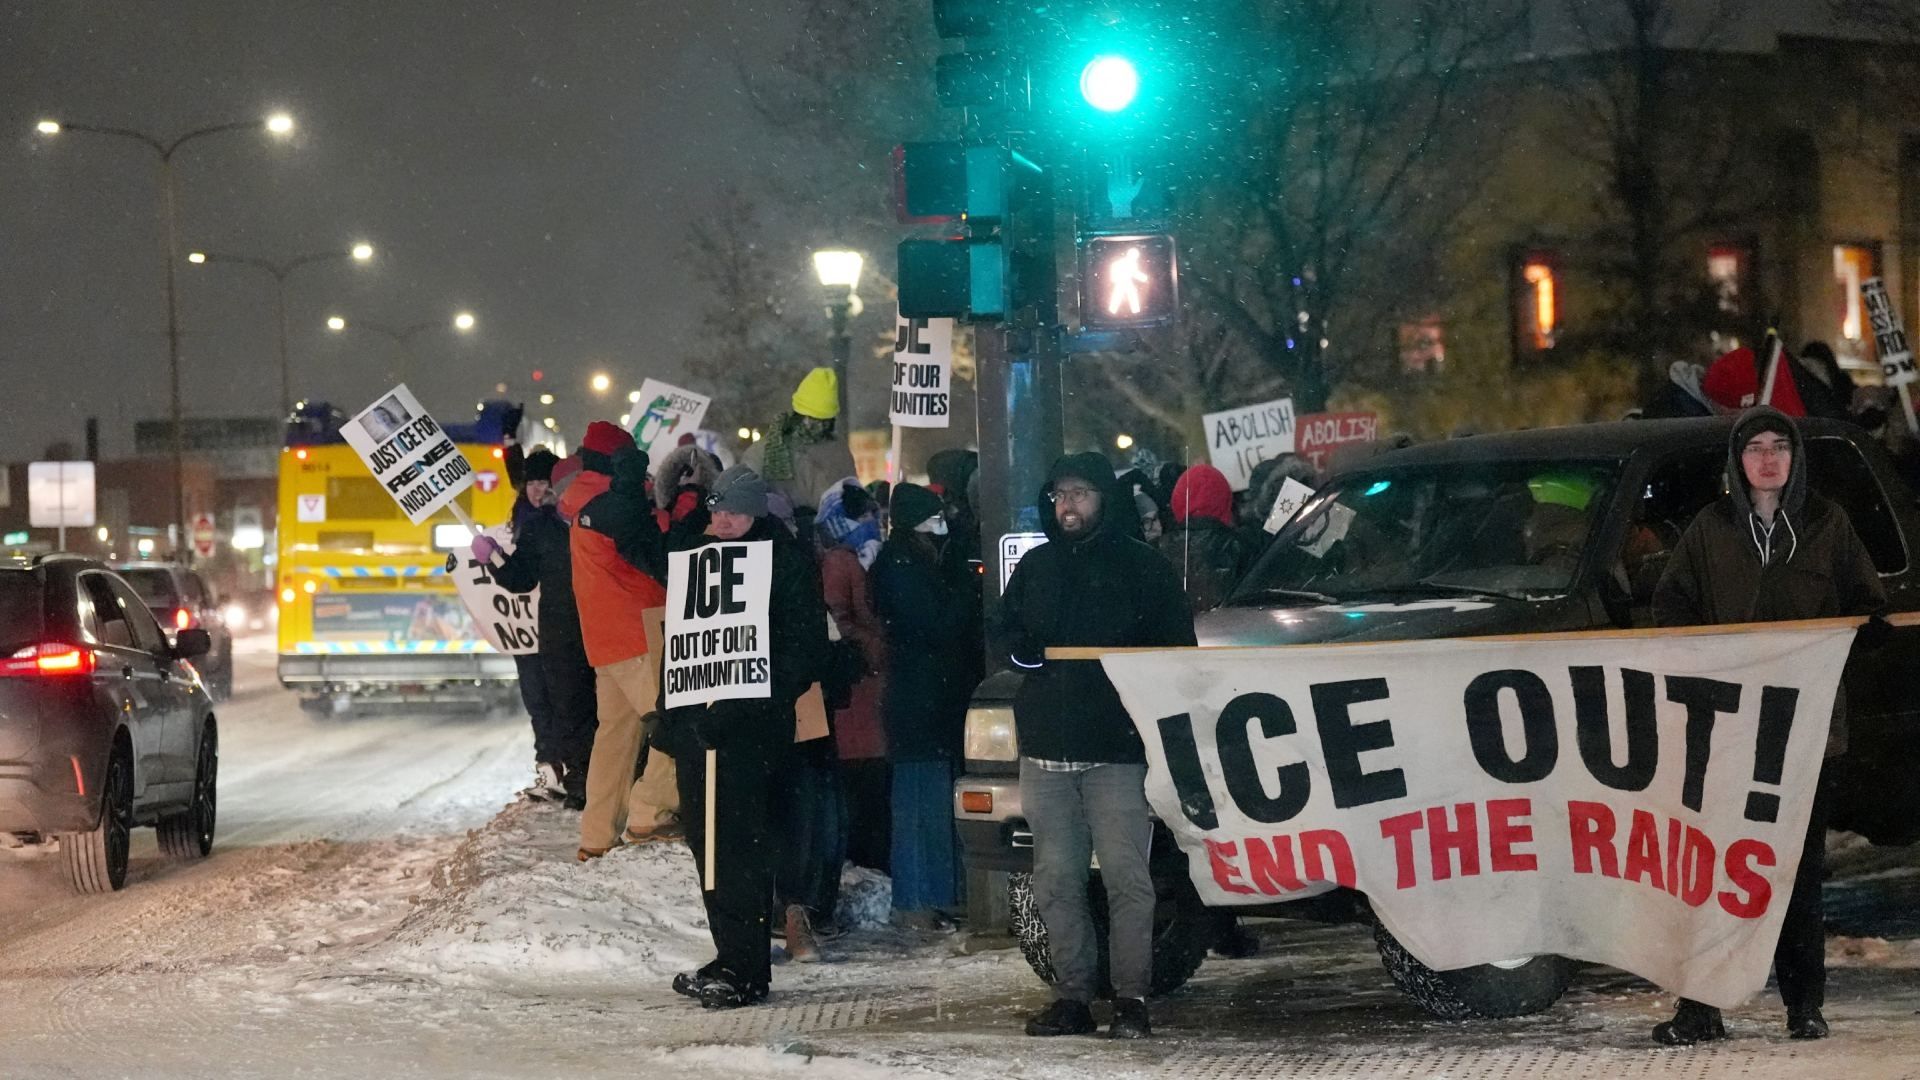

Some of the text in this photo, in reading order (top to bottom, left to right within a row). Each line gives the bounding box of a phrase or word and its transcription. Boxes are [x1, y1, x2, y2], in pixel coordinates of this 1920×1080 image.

[908, 363, 941, 388] OUR
[669, 393, 702, 414] RESIST
[369, 414, 439, 475] JUSTICE FOR
[1215, 406, 1293, 449] ABOLISH
[1302, 417, 1377, 450] ABOLISH
[386, 439, 455, 493] RENEE
[400, 455, 472, 515] NICOLE GOOD
[683, 546, 748, 620] ICE
[493, 594, 533, 619] OUT
[671, 625, 757, 662] OUT OF OUR
[667, 657, 769, 695] COMMUNITIES
[1157, 665, 1800, 831] ICE OUT!
[1203, 798, 1777, 919] END THE RAIDS
